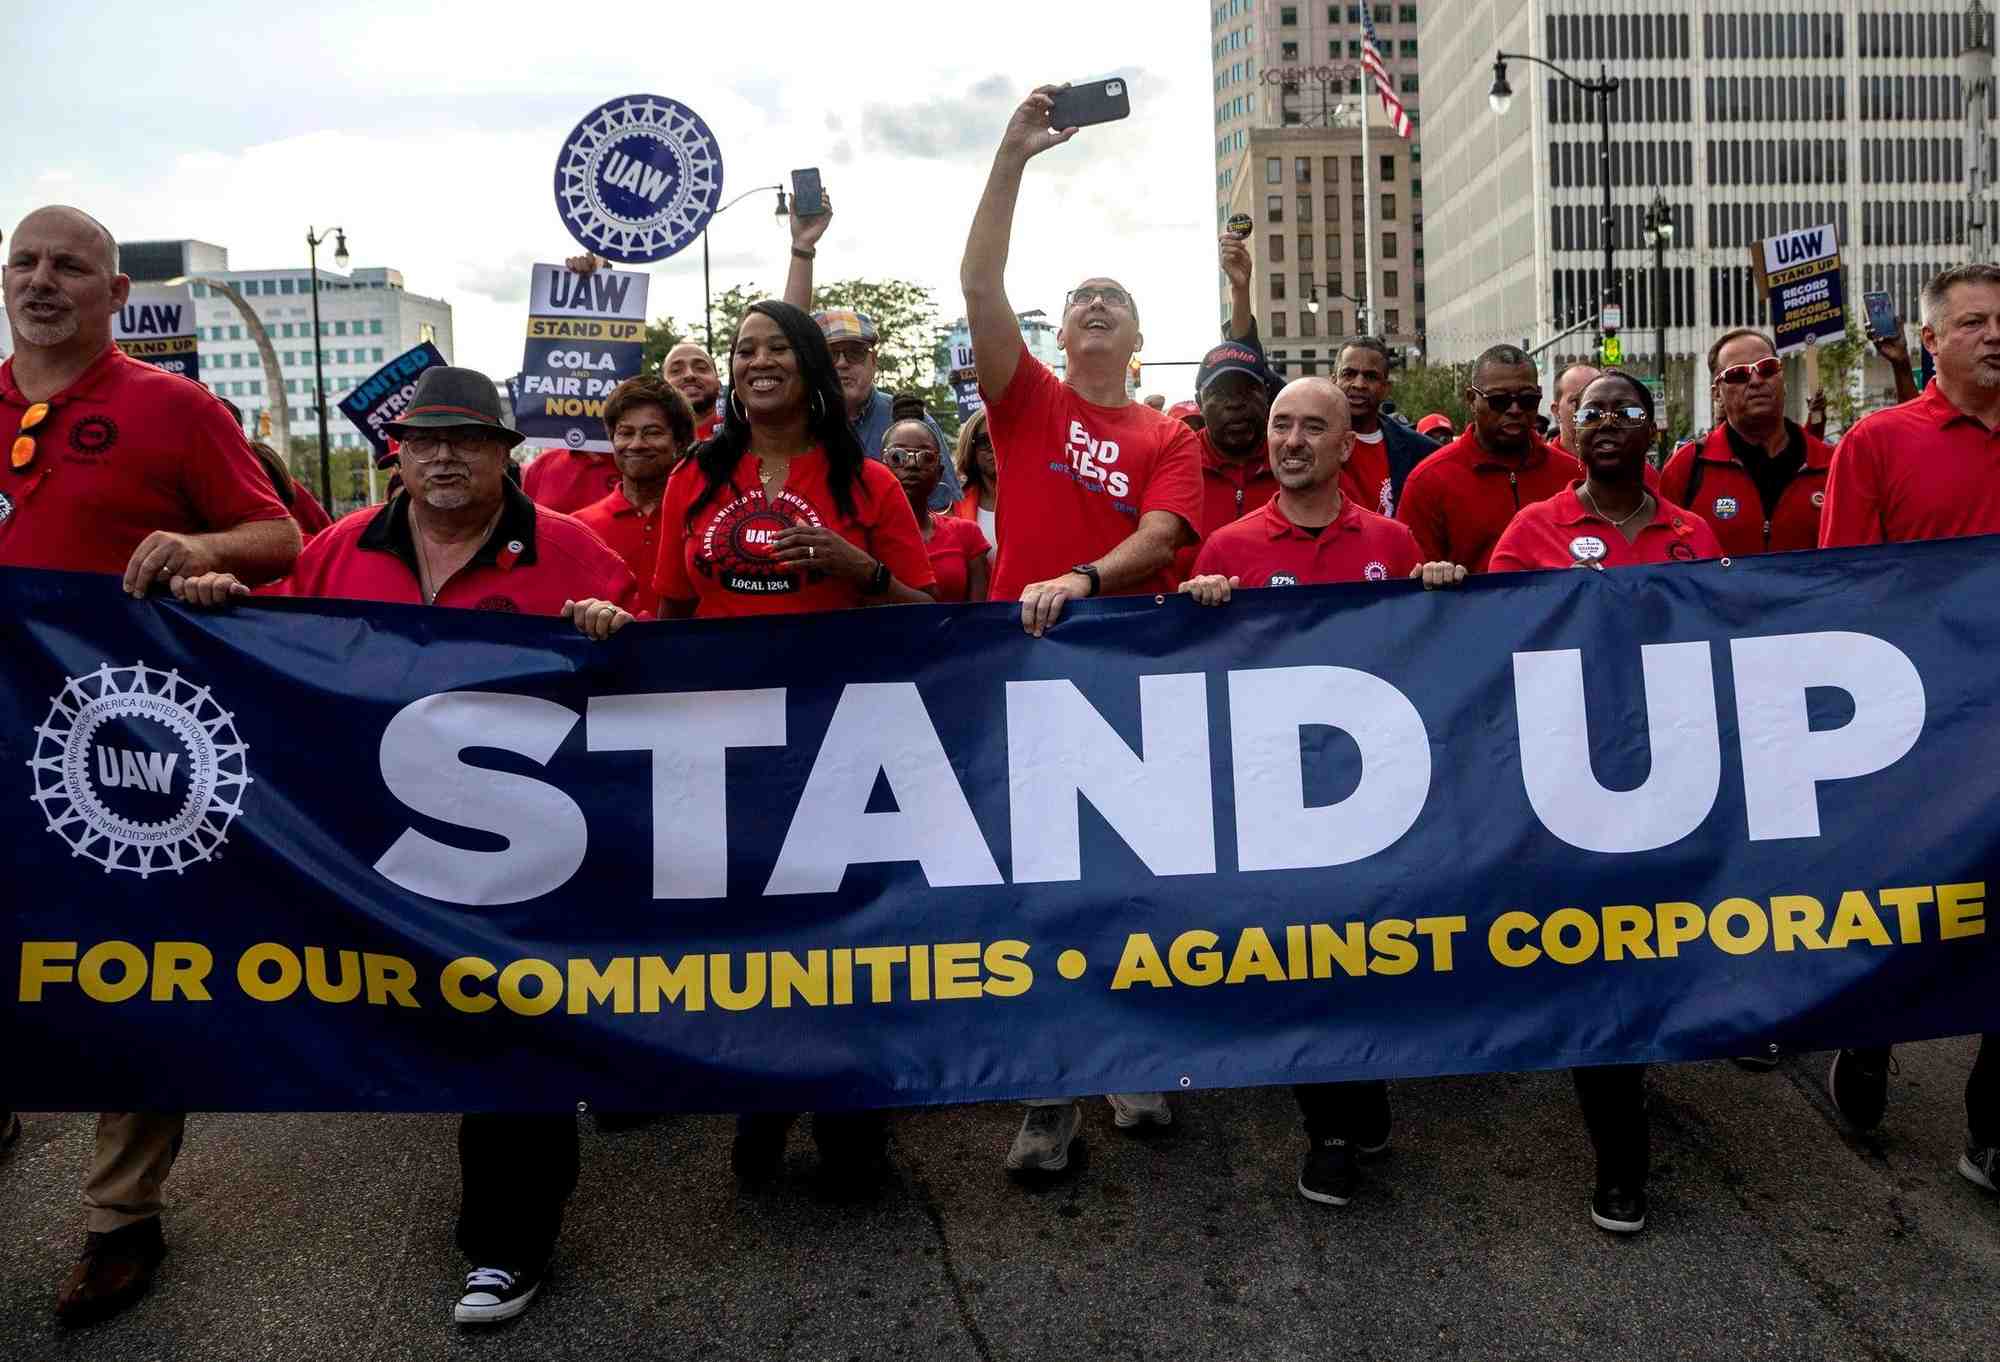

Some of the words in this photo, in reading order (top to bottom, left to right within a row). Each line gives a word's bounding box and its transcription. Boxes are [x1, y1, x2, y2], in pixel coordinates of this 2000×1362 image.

[603, 151, 673, 203] UAW
[1775, 230, 1823, 264] UAW
[1775, 266, 1814, 284] STAND
[1817, 259, 1834, 272] UP
[550, 270, 631, 313] UAW
[1782, 278, 1829, 300] RECORD
[1784, 288, 1830, 310] PROFITS
[120, 305, 181, 334] UAW
[1777, 307, 1841, 334] CONTRACTS
[1785, 301, 1830, 322] RECORD
[532, 321, 602, 337] STAND
[609, 324, 638, 338] UP
[119, 341, 167, 355] TAND
[173, 339, 192, 351] UP
[547, 350, 616, 371] COLA
[351, 350, 429, 411] UNITED
[524, 375, 580, 396] FAIR
[570, 370, 590, 378] AND
[367, 380, 418, 430] STRO
[546, 397, 608, 417] NOW
[749, 489, 809, 511] STONGER
[807, 510, 823, 528] THA
[731, 578, 765, 591] LOCAL
[767, 580, 790, 591] 1264
[1271, 576, 1295, 585] 97%
[91, 698, 137, 716] AMERICA
[140, 699, 178, 718] UNITED
[177, 715, 210, 774] AUTOMOBILE
[96, 744, 179, 794] UAW
[373, 664, 1432, 906] STAND
[1511, 630, 1926, 854] UP
[98, 816, 168, 841] AGRICULTURAL
[19, 941, 213, 1002] FOR
[237, 942, 422, 1009] OUR
[440, 940, 1033, 1016] COMMUNITIES
[1111, 916, 1467, 990] AGAINST
[1488, 881, 1987, 968] CORPORATE
